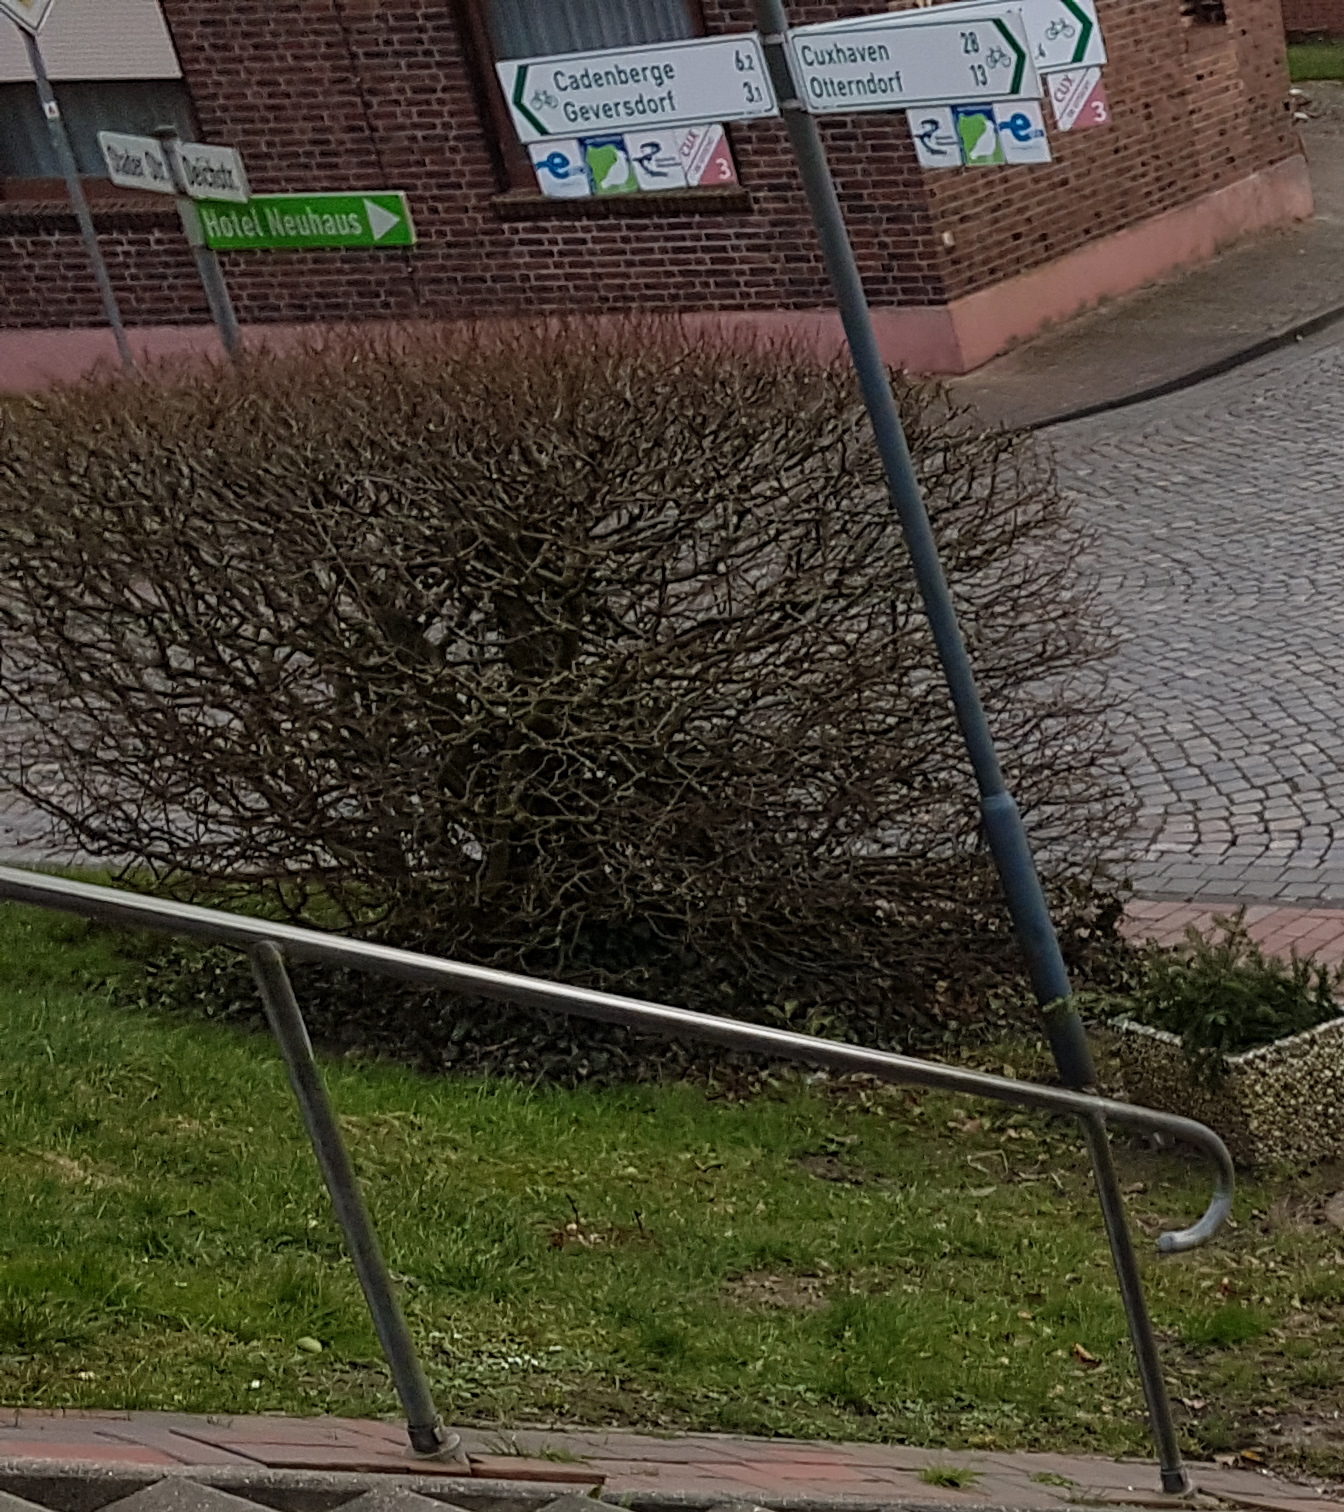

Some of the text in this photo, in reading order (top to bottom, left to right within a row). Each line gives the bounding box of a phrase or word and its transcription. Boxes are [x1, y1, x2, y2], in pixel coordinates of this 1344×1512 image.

[801, 31, 980, 67] Cuxhaven 28
[553, 62, 676, 92] Cadenberge
[810, 64, 988, 99] Otterndorf 13
[563, 91, 677, 123] Geversdorf
[1091, 100, 1107, 122] 3
[714, 157, 732, 180] 3
[203, 206, 363, 239] Hotel Neuhaus
